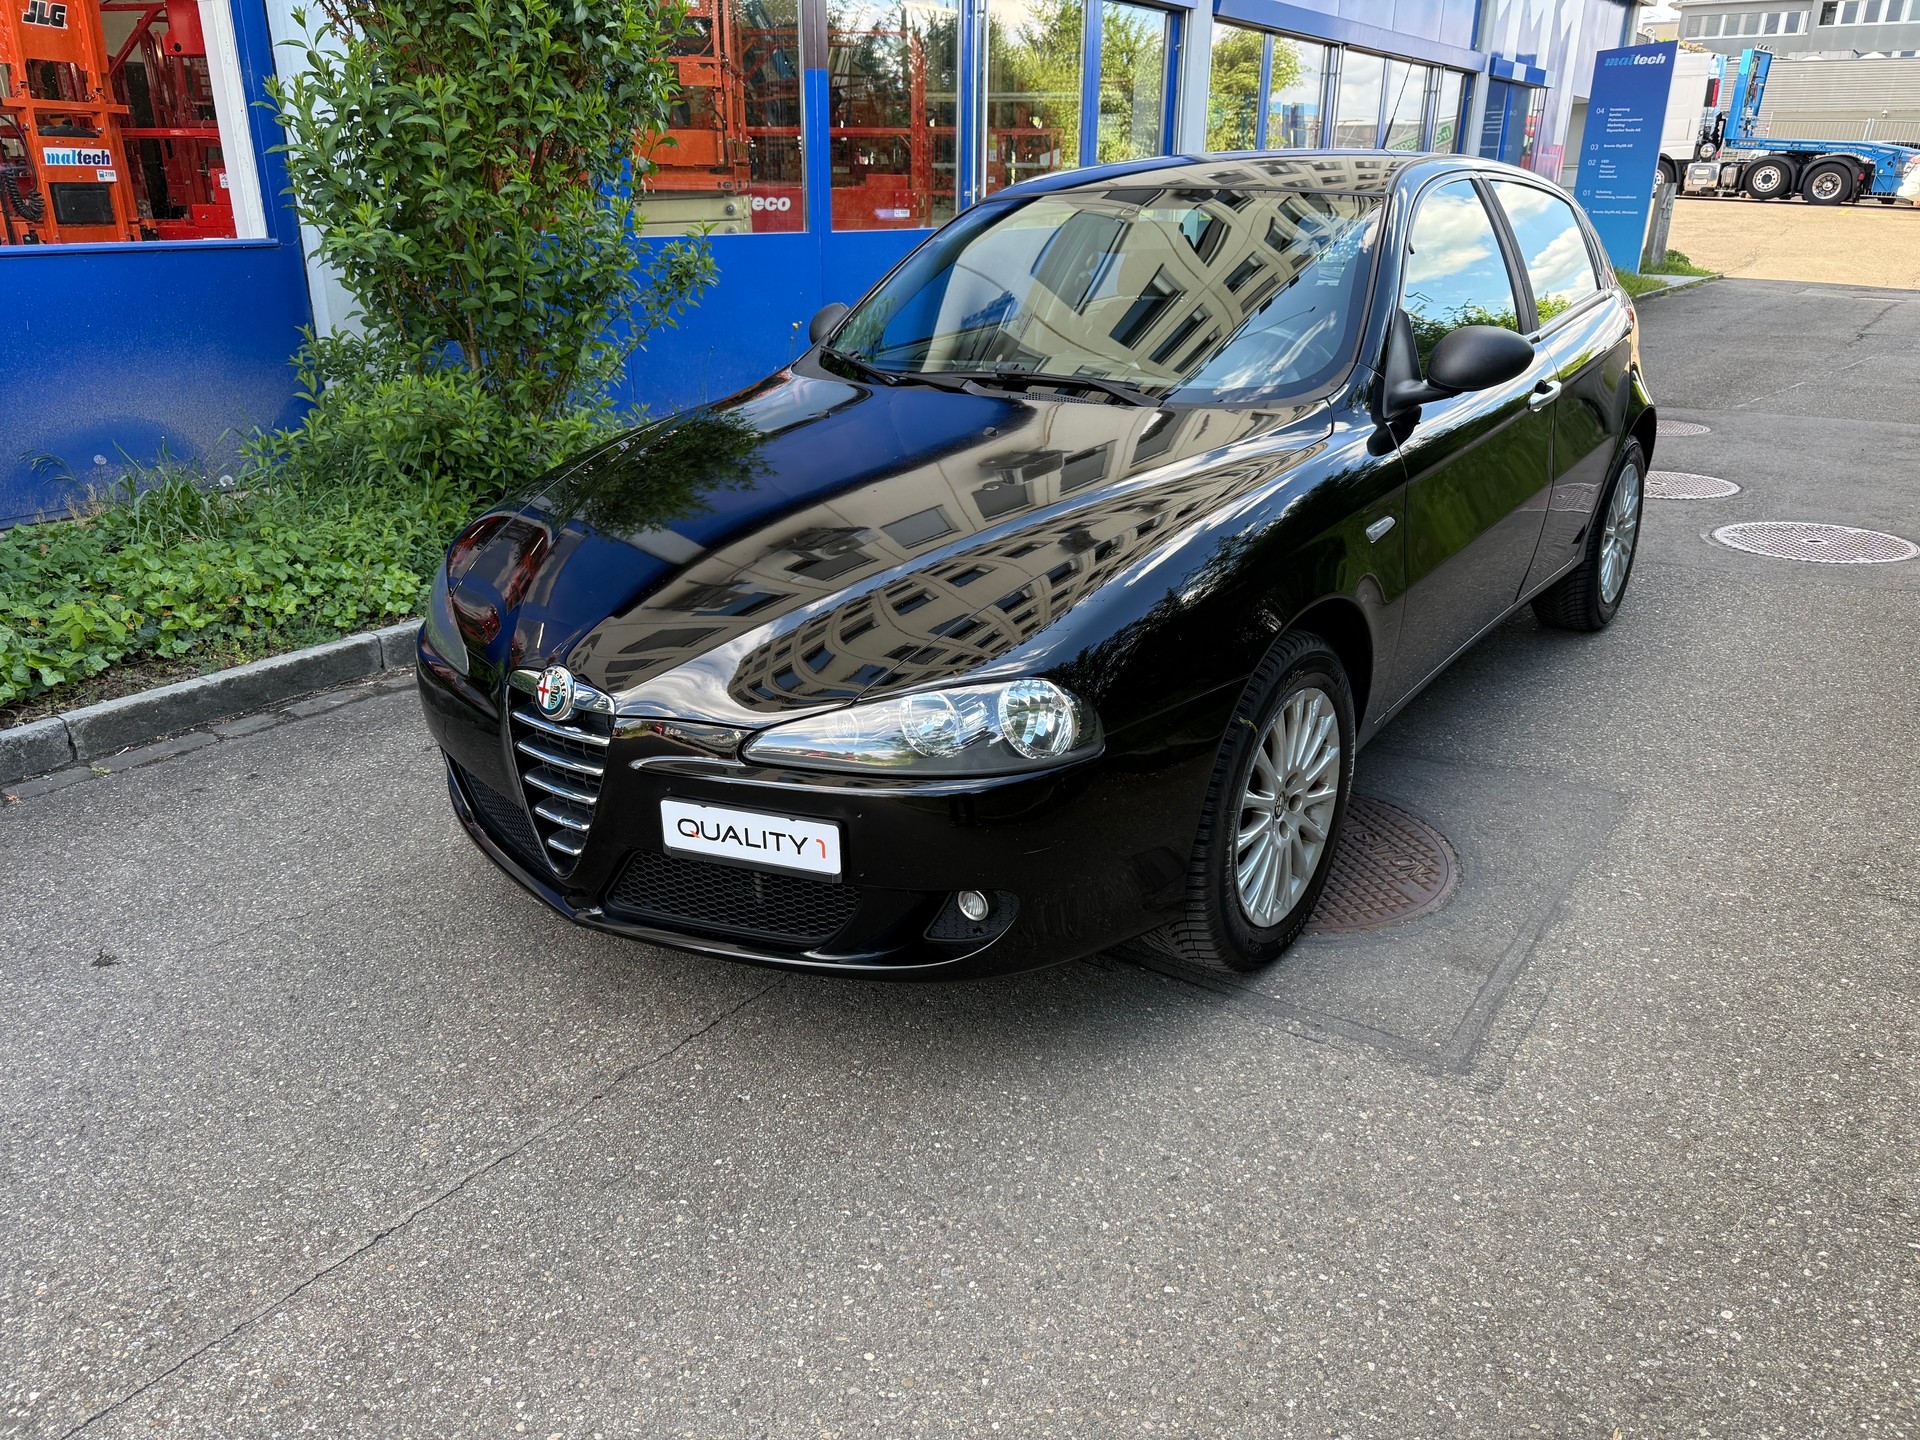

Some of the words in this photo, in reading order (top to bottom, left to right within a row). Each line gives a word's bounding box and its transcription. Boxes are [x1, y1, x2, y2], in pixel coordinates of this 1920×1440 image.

[22, 0, 67, 28] JLG
[1604, 53, 1666, 66] maltech
[46, 150, 110, 165] maltech
[750, 197, 791, 211] eco
[677, 818, 808, 855] QUALITY
[816, 838, 827, 859] 1
